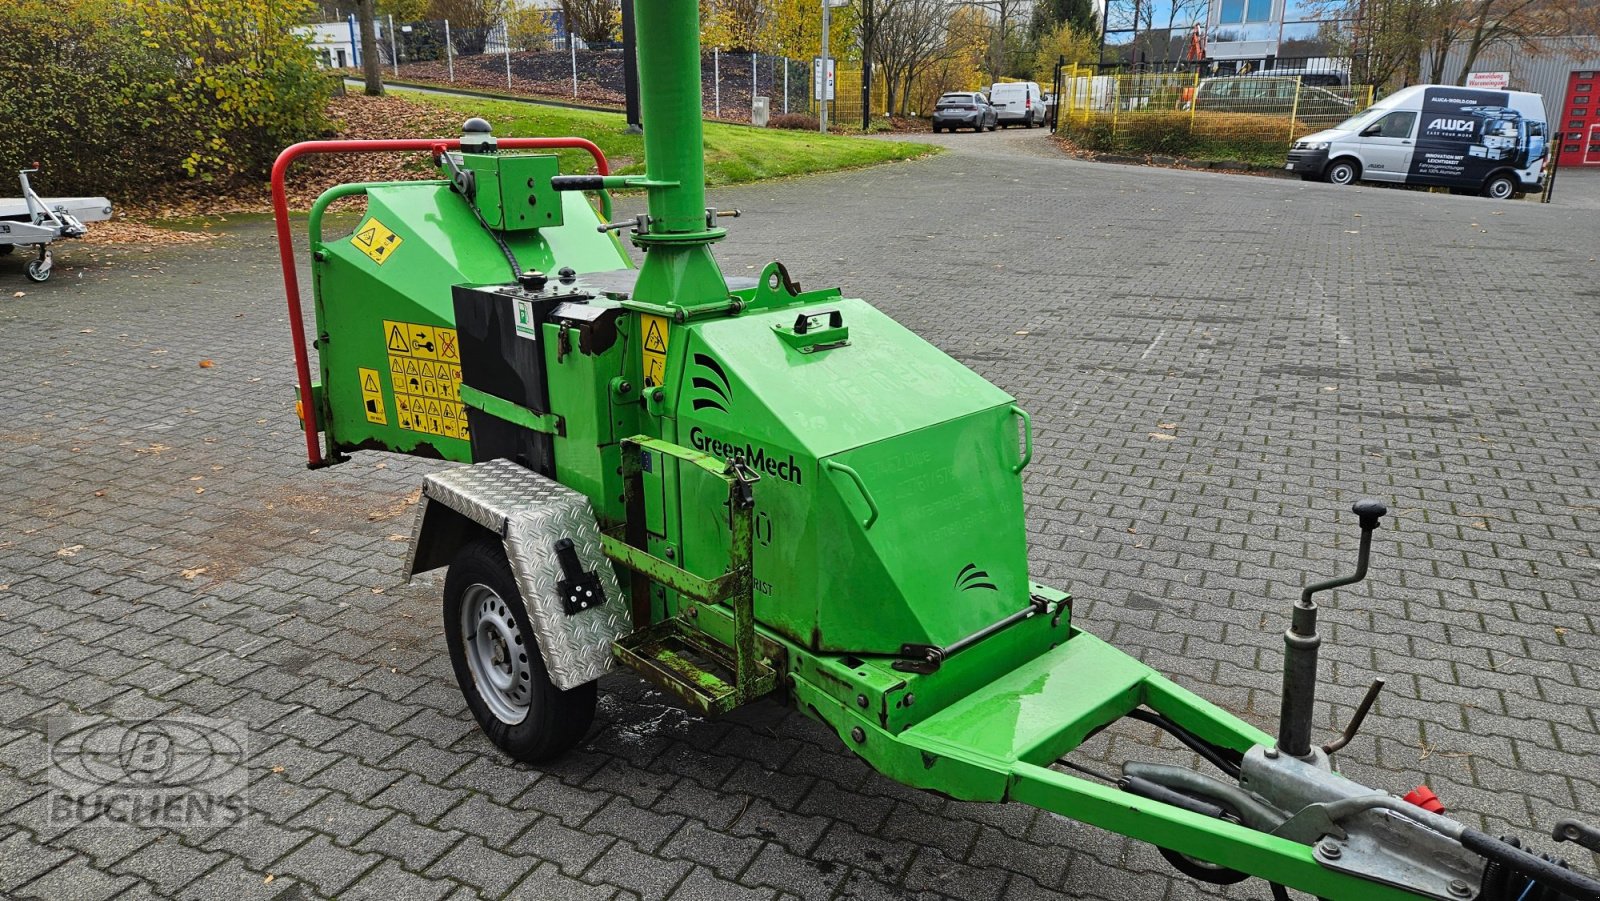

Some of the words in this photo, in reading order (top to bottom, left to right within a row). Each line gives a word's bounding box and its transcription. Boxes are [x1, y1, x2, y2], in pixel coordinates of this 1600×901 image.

[1431, 97, 1477, 105] ALUCA-WORLD.COM
[1427, 118, 1475, 132] ALUCA
[690, 426, 802, 486] GreenMech
